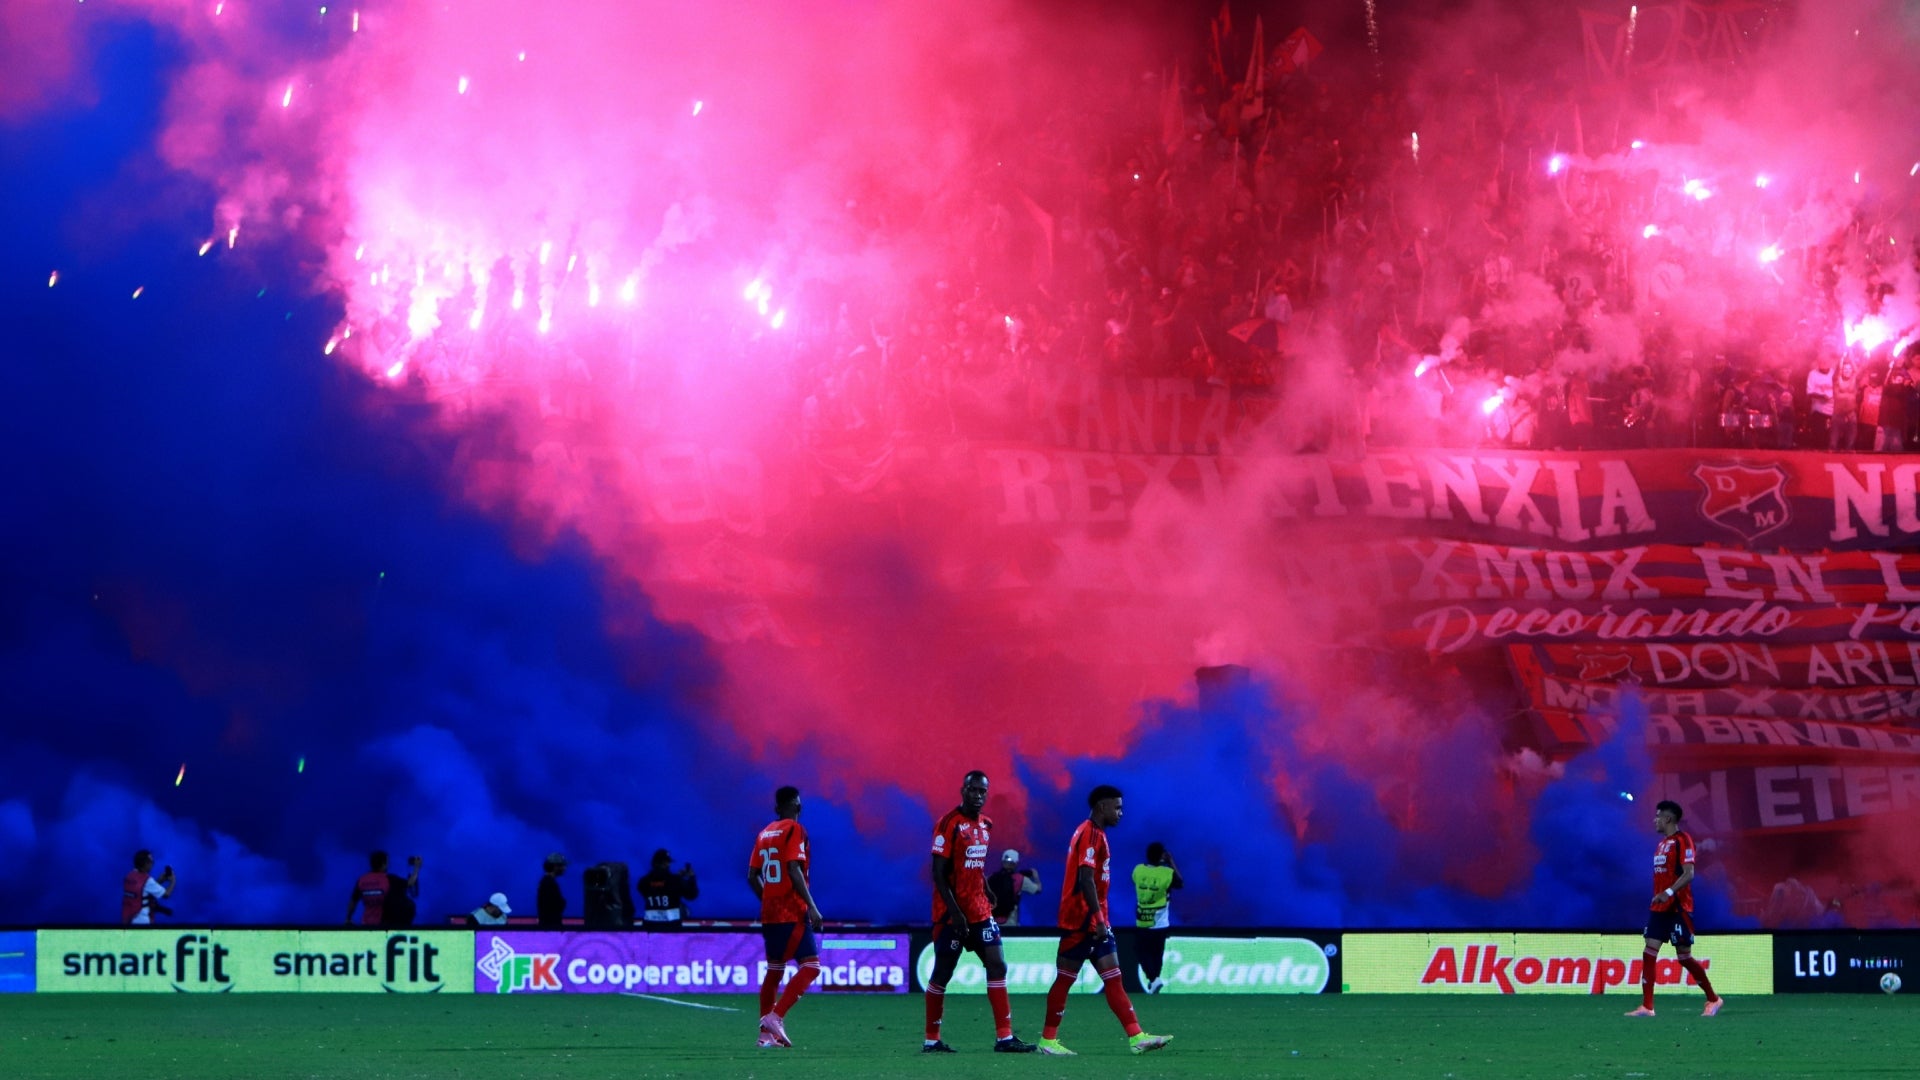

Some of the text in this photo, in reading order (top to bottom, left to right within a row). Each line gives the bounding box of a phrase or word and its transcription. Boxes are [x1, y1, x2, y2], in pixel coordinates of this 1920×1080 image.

[1716, 475, 1736, 492] D
[1753, 511, 1776, 527] M
[1692, 547, 1836, 603] EN
[1412, 600, 1803, 654] Decorando
[1646, 642, 1780, 684] DON
[1544, 678, 1706, 716] MOA
[648, 895, 669, 907] 118
[1675, 923, 1683, 936] 4
[63, 934, 230, 982] smart fit
[273, 935, 440, 982] smart fit
[497, 954, 905, 993] JFK Cooperativa Fnnciera
[1795, 949, 1836, 976] LEO
